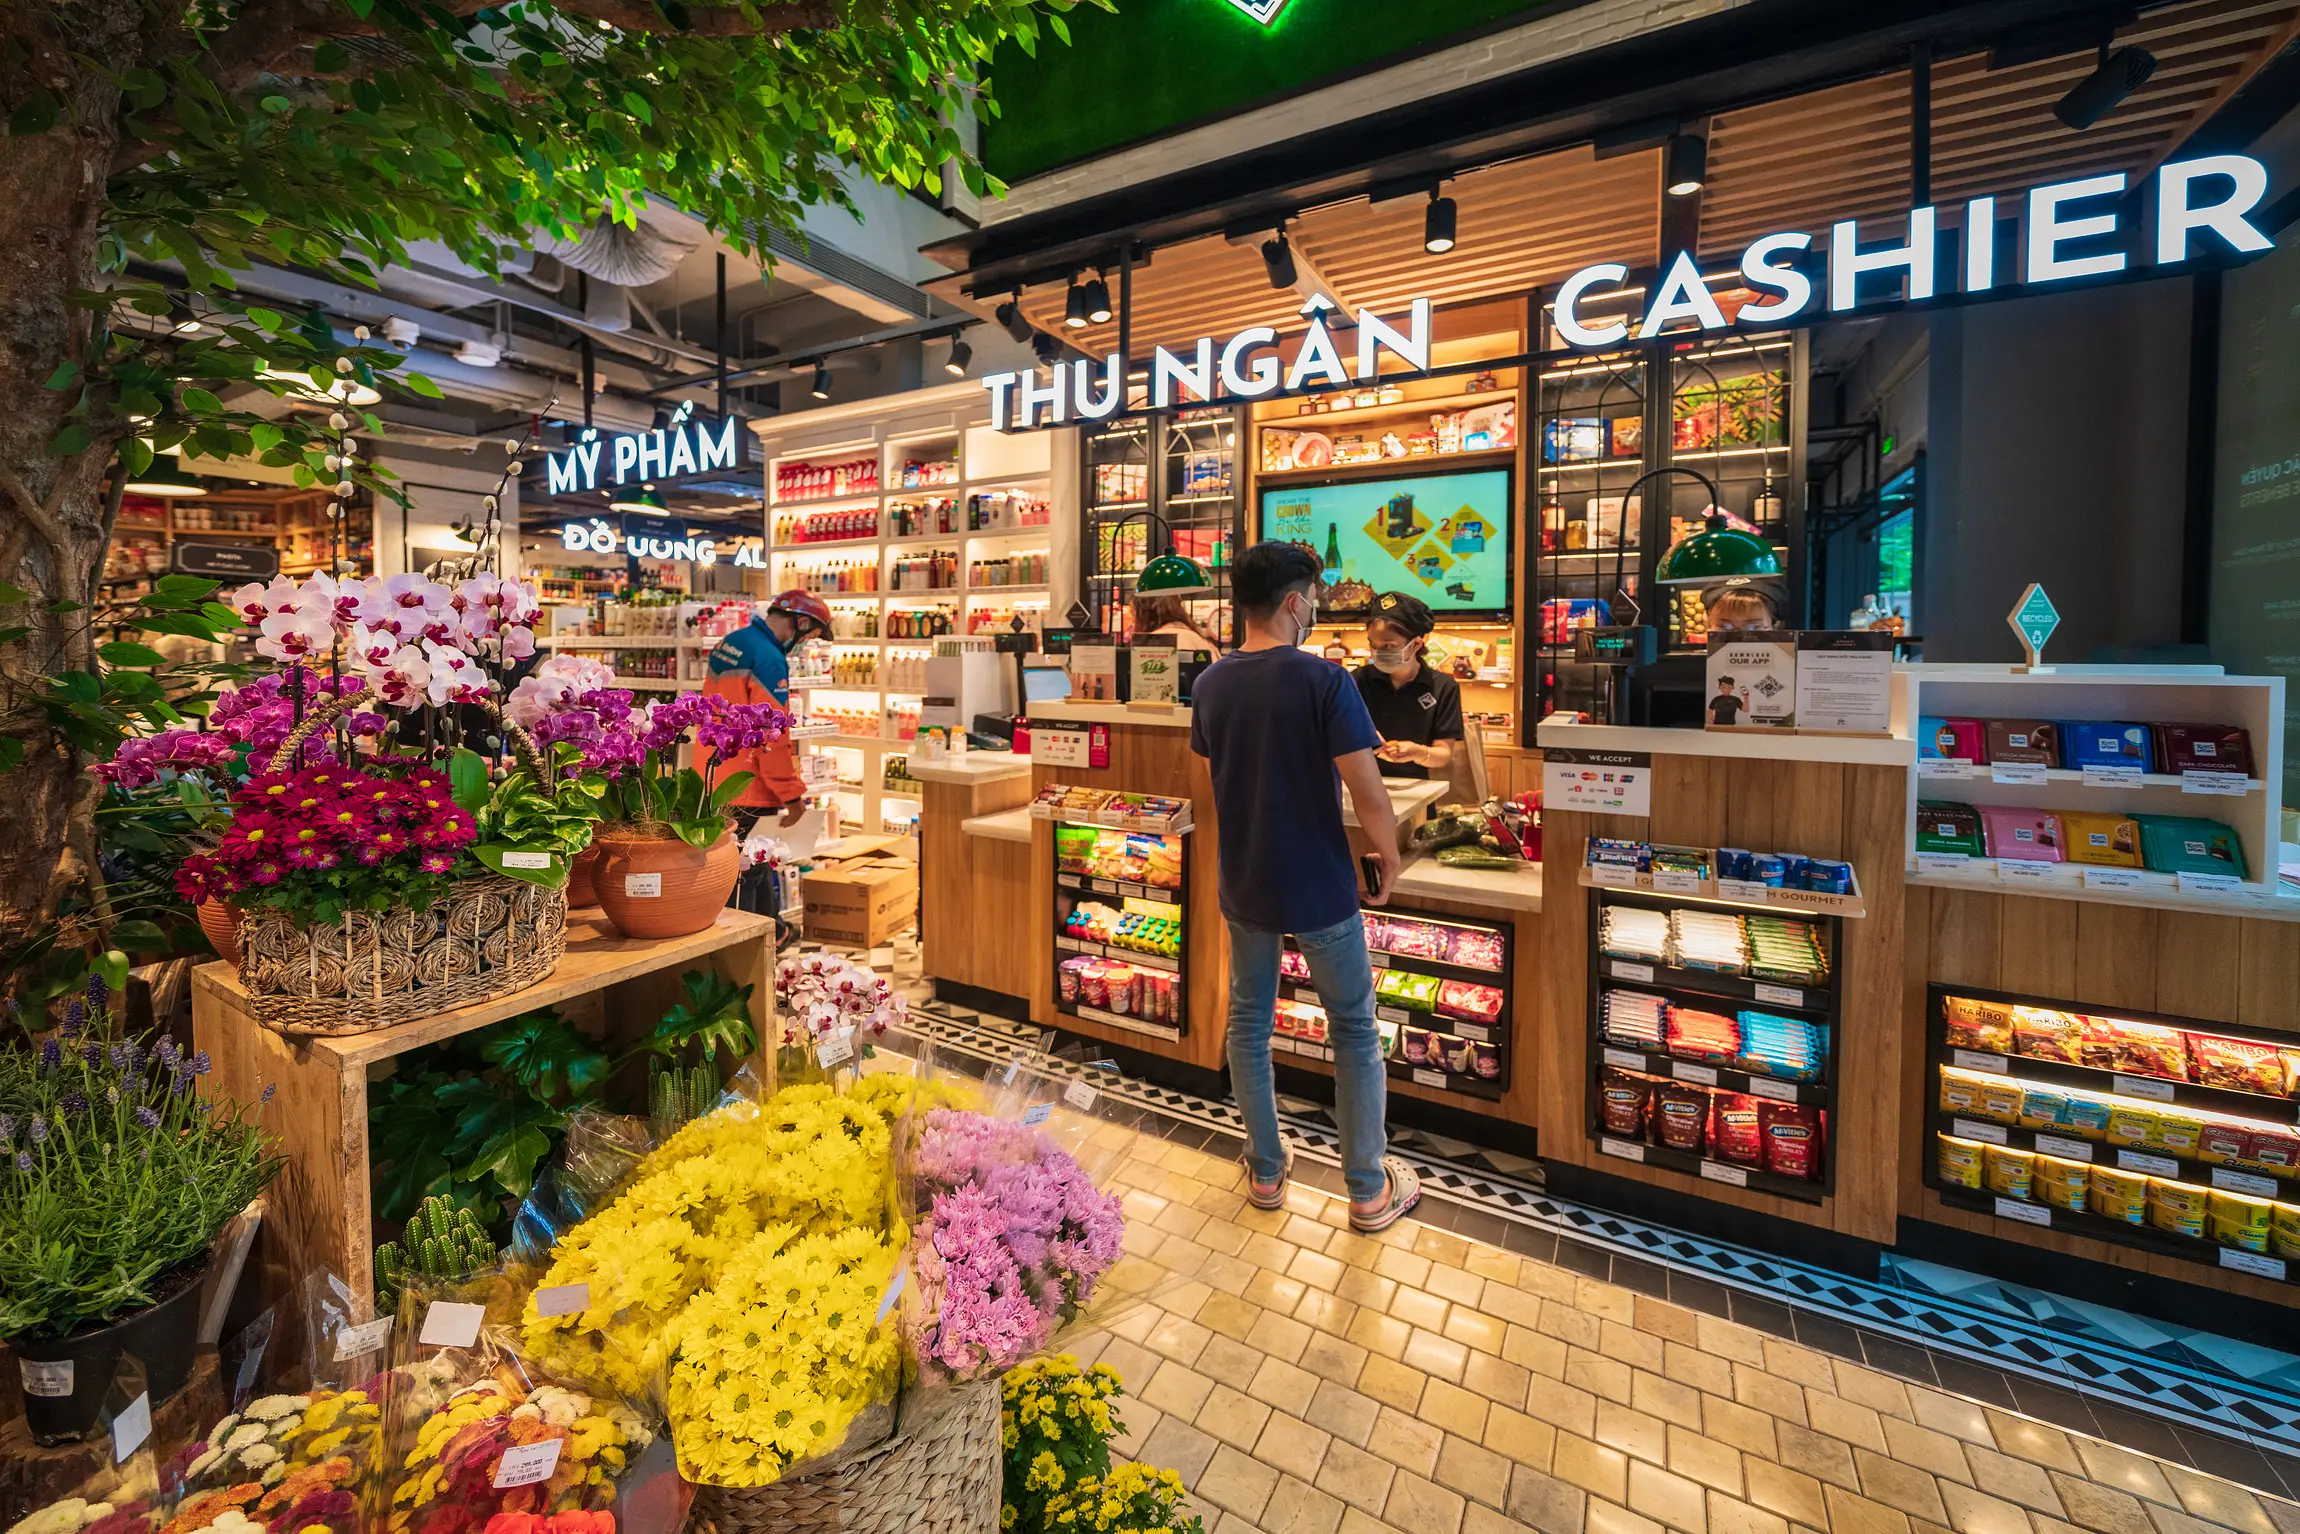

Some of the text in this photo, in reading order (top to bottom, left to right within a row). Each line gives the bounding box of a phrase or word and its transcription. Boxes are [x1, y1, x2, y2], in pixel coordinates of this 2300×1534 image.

[1553, 154, 2275, 348] CASHIER
[982, 293, 1429, 431] THU NGÂN
[547, 400, 737, 496] MỸ PHẨM
[1276, 504, 1311, 518] CROWN
[1376, 506, 1384, 527] 1
[1276, 522, 1313, 536] KING
[1440, 518, 1450, 532] 2
[563, 518, 617, 554] ĐỒ
[1408, 553, 1416, 564] 3
[2022, 614, 2053, 622] RECYCLED
[1780, 892, 1845, 906] GOURMET
[1959, 1005, 2002, 1021] HARIBO
[1984, 1088, 2017, 1099] Ricola
[1957, 1107, 1996, 1119] Ricola
[2116, 1112, 2153, 1124] Ricola
[1773, 1127, 1807, 1136] McVitie's
[2042, 1123, 2083, 1136] Ricola
[2161, 1121, 2199, 1132] Ricola
[2206, 1128, 2248, 1140] Ricola
[1775, 1138, 1806, 1150] Digestive
[2129, 1141, 2173, 1154] Ricola
[2254, 1136, 2298, 1149] Ricola
[2222, 1158, 2270, 1172] Ricola
[2160, 1187, 2190, 1200] Ricola
